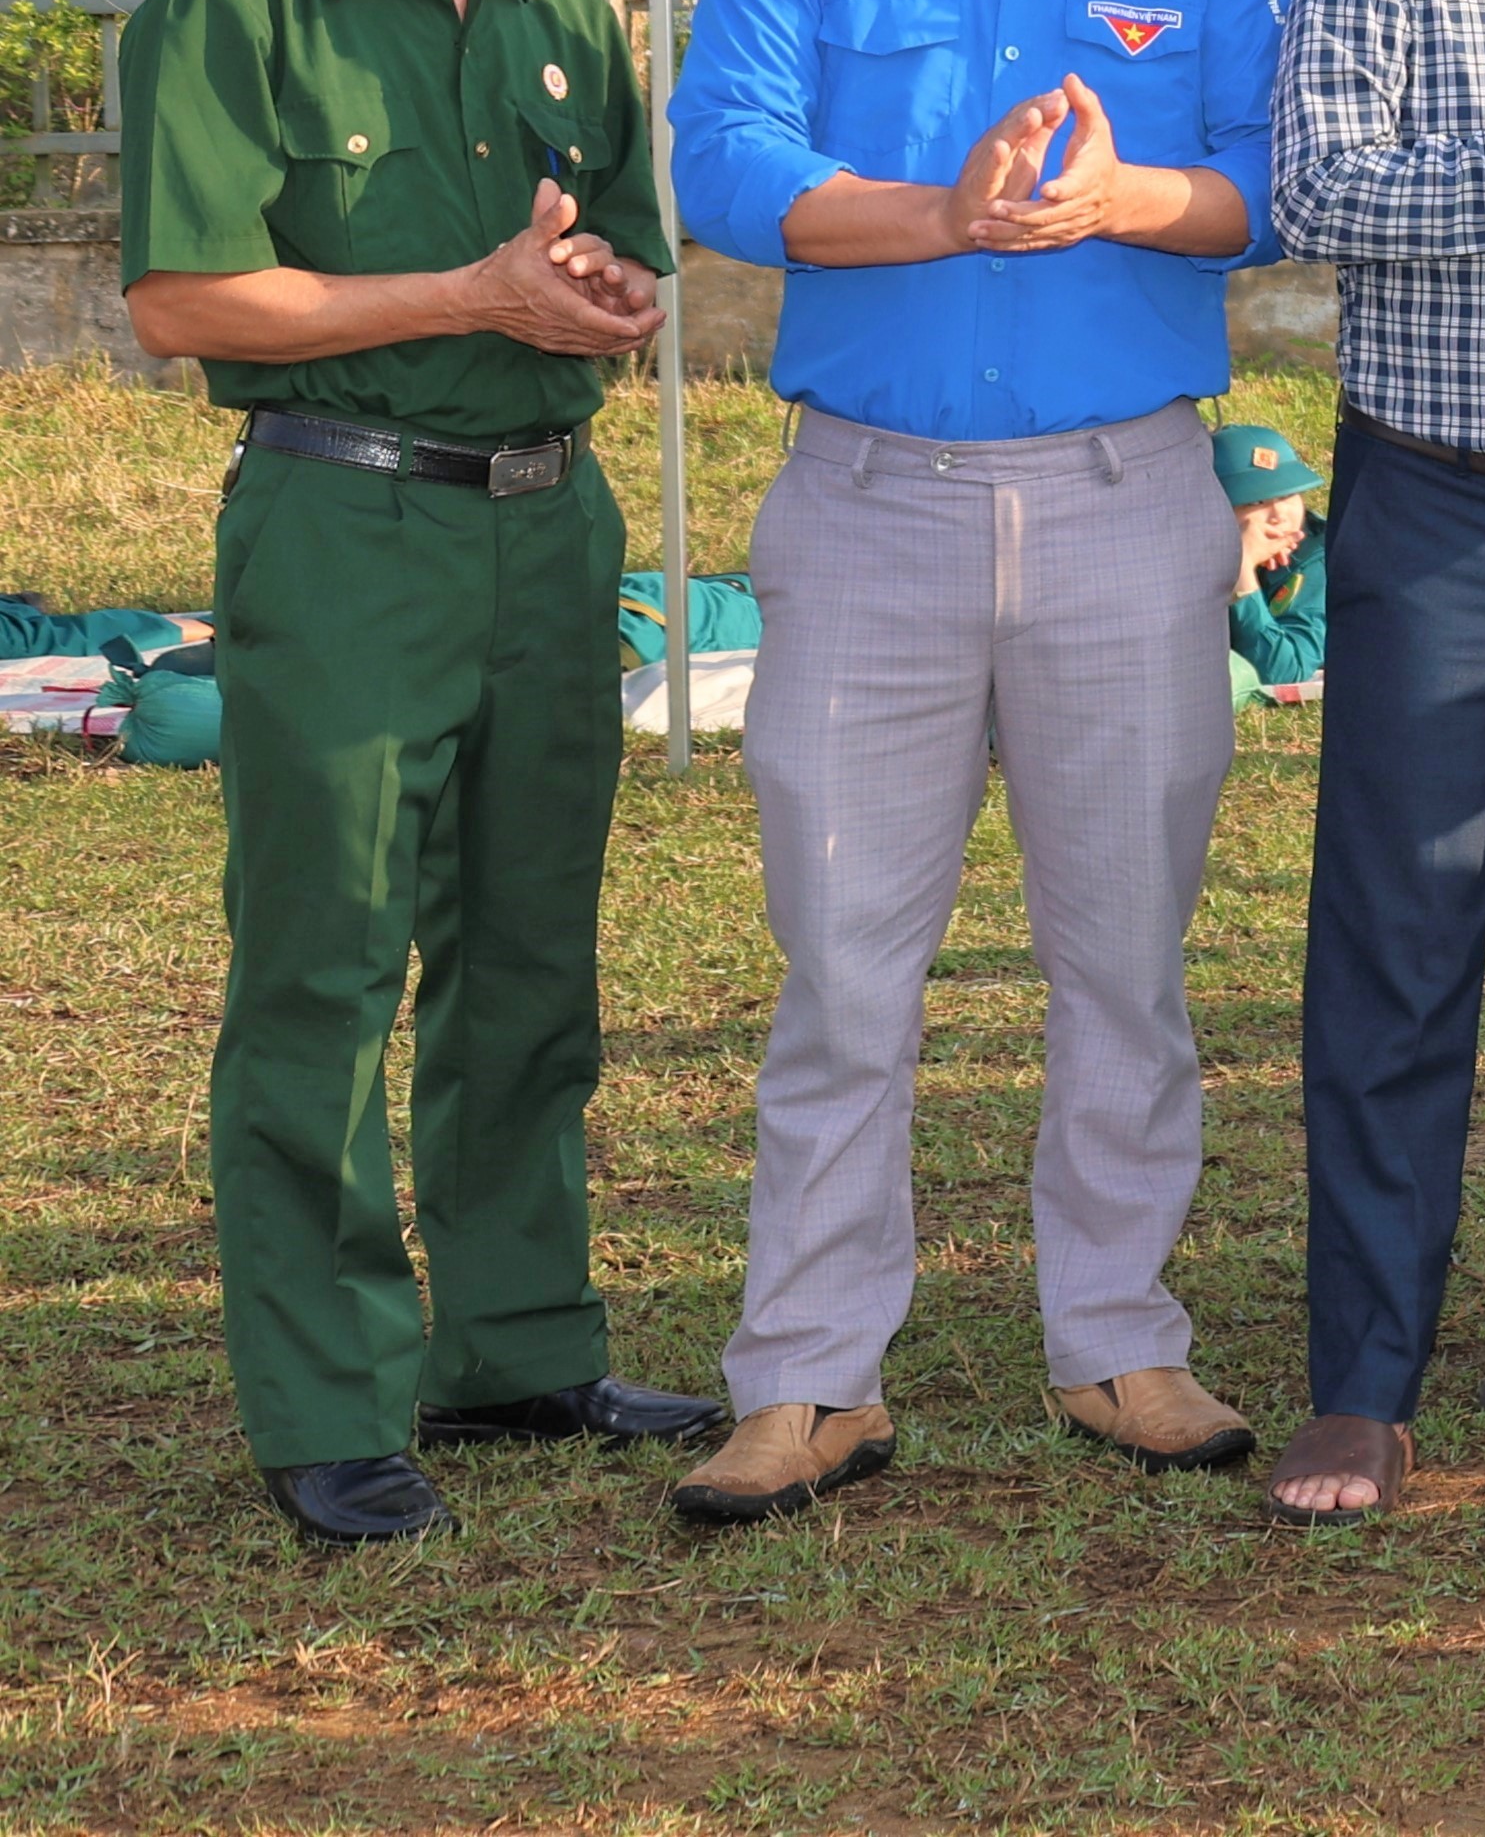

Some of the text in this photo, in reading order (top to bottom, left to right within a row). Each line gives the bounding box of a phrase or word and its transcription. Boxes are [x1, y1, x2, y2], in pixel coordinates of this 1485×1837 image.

[1092, 5, 1177, 23] THANH NIÊN VIỆT NAM
